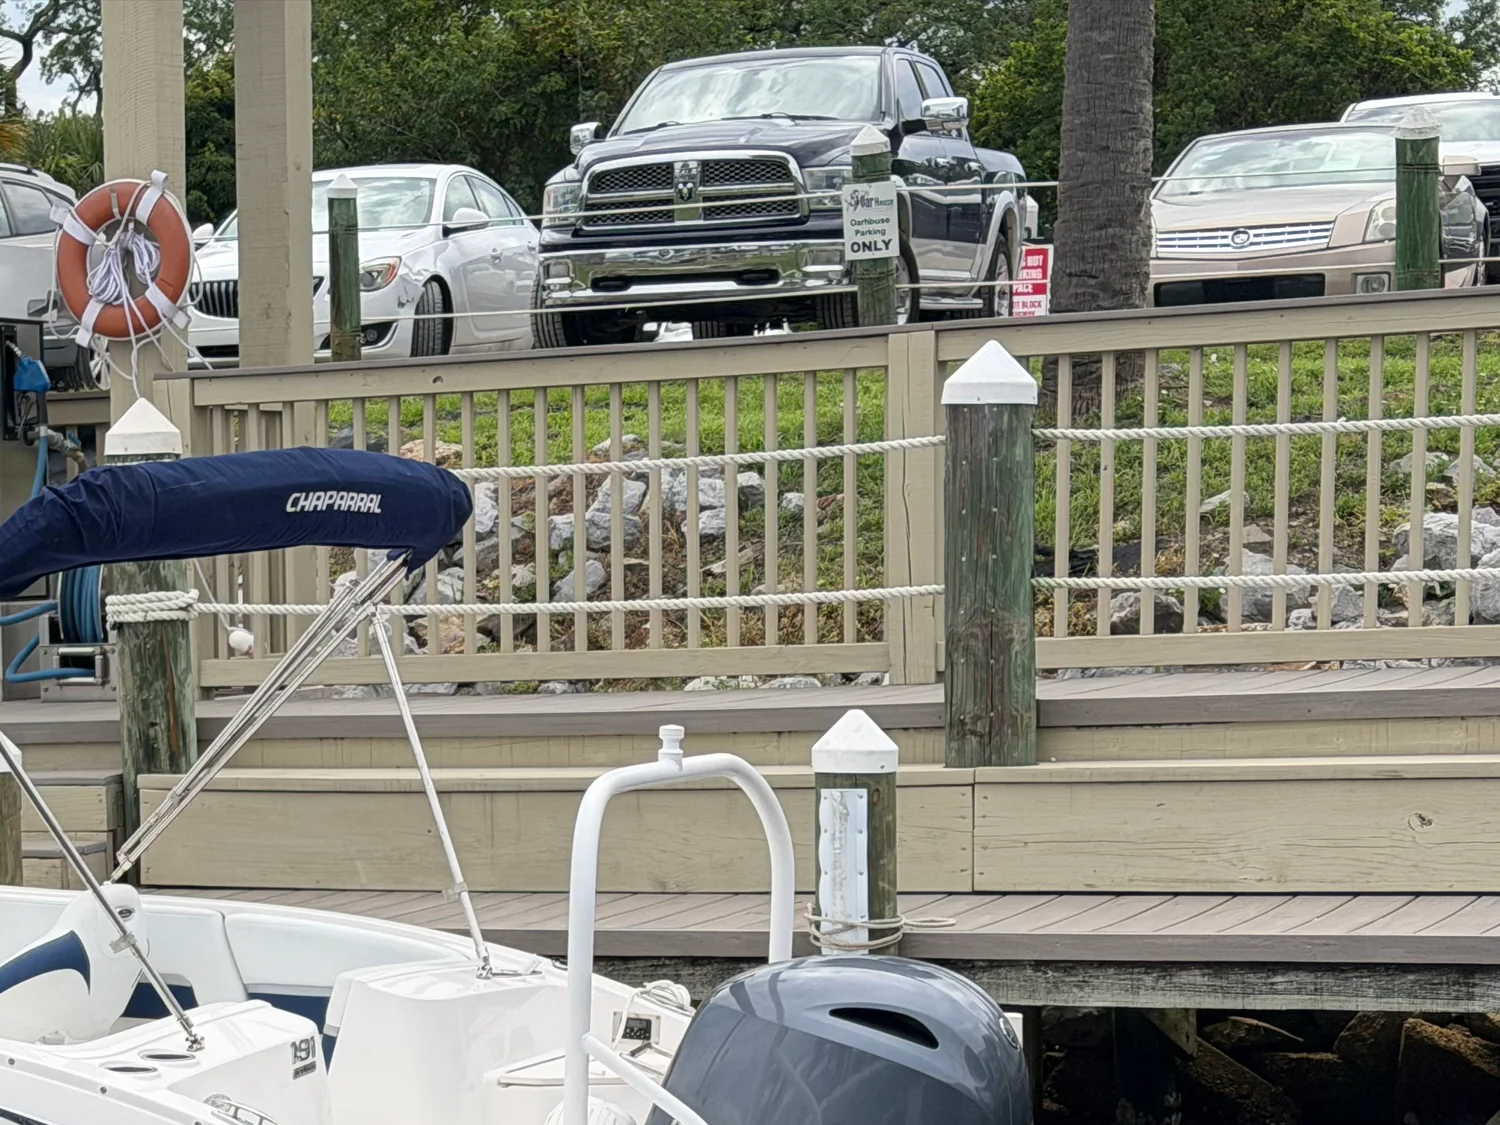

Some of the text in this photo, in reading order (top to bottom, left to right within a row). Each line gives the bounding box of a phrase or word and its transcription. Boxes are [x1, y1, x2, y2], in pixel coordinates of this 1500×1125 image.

[850, 217, 890, 227] Oarhouse
[855, 228, 886, 237] Parking
[850, 238, 893, 253] ONLY
[285, 490, 382, 514] CHAPARRAL
[290, 1035, 316, 1065] 191
